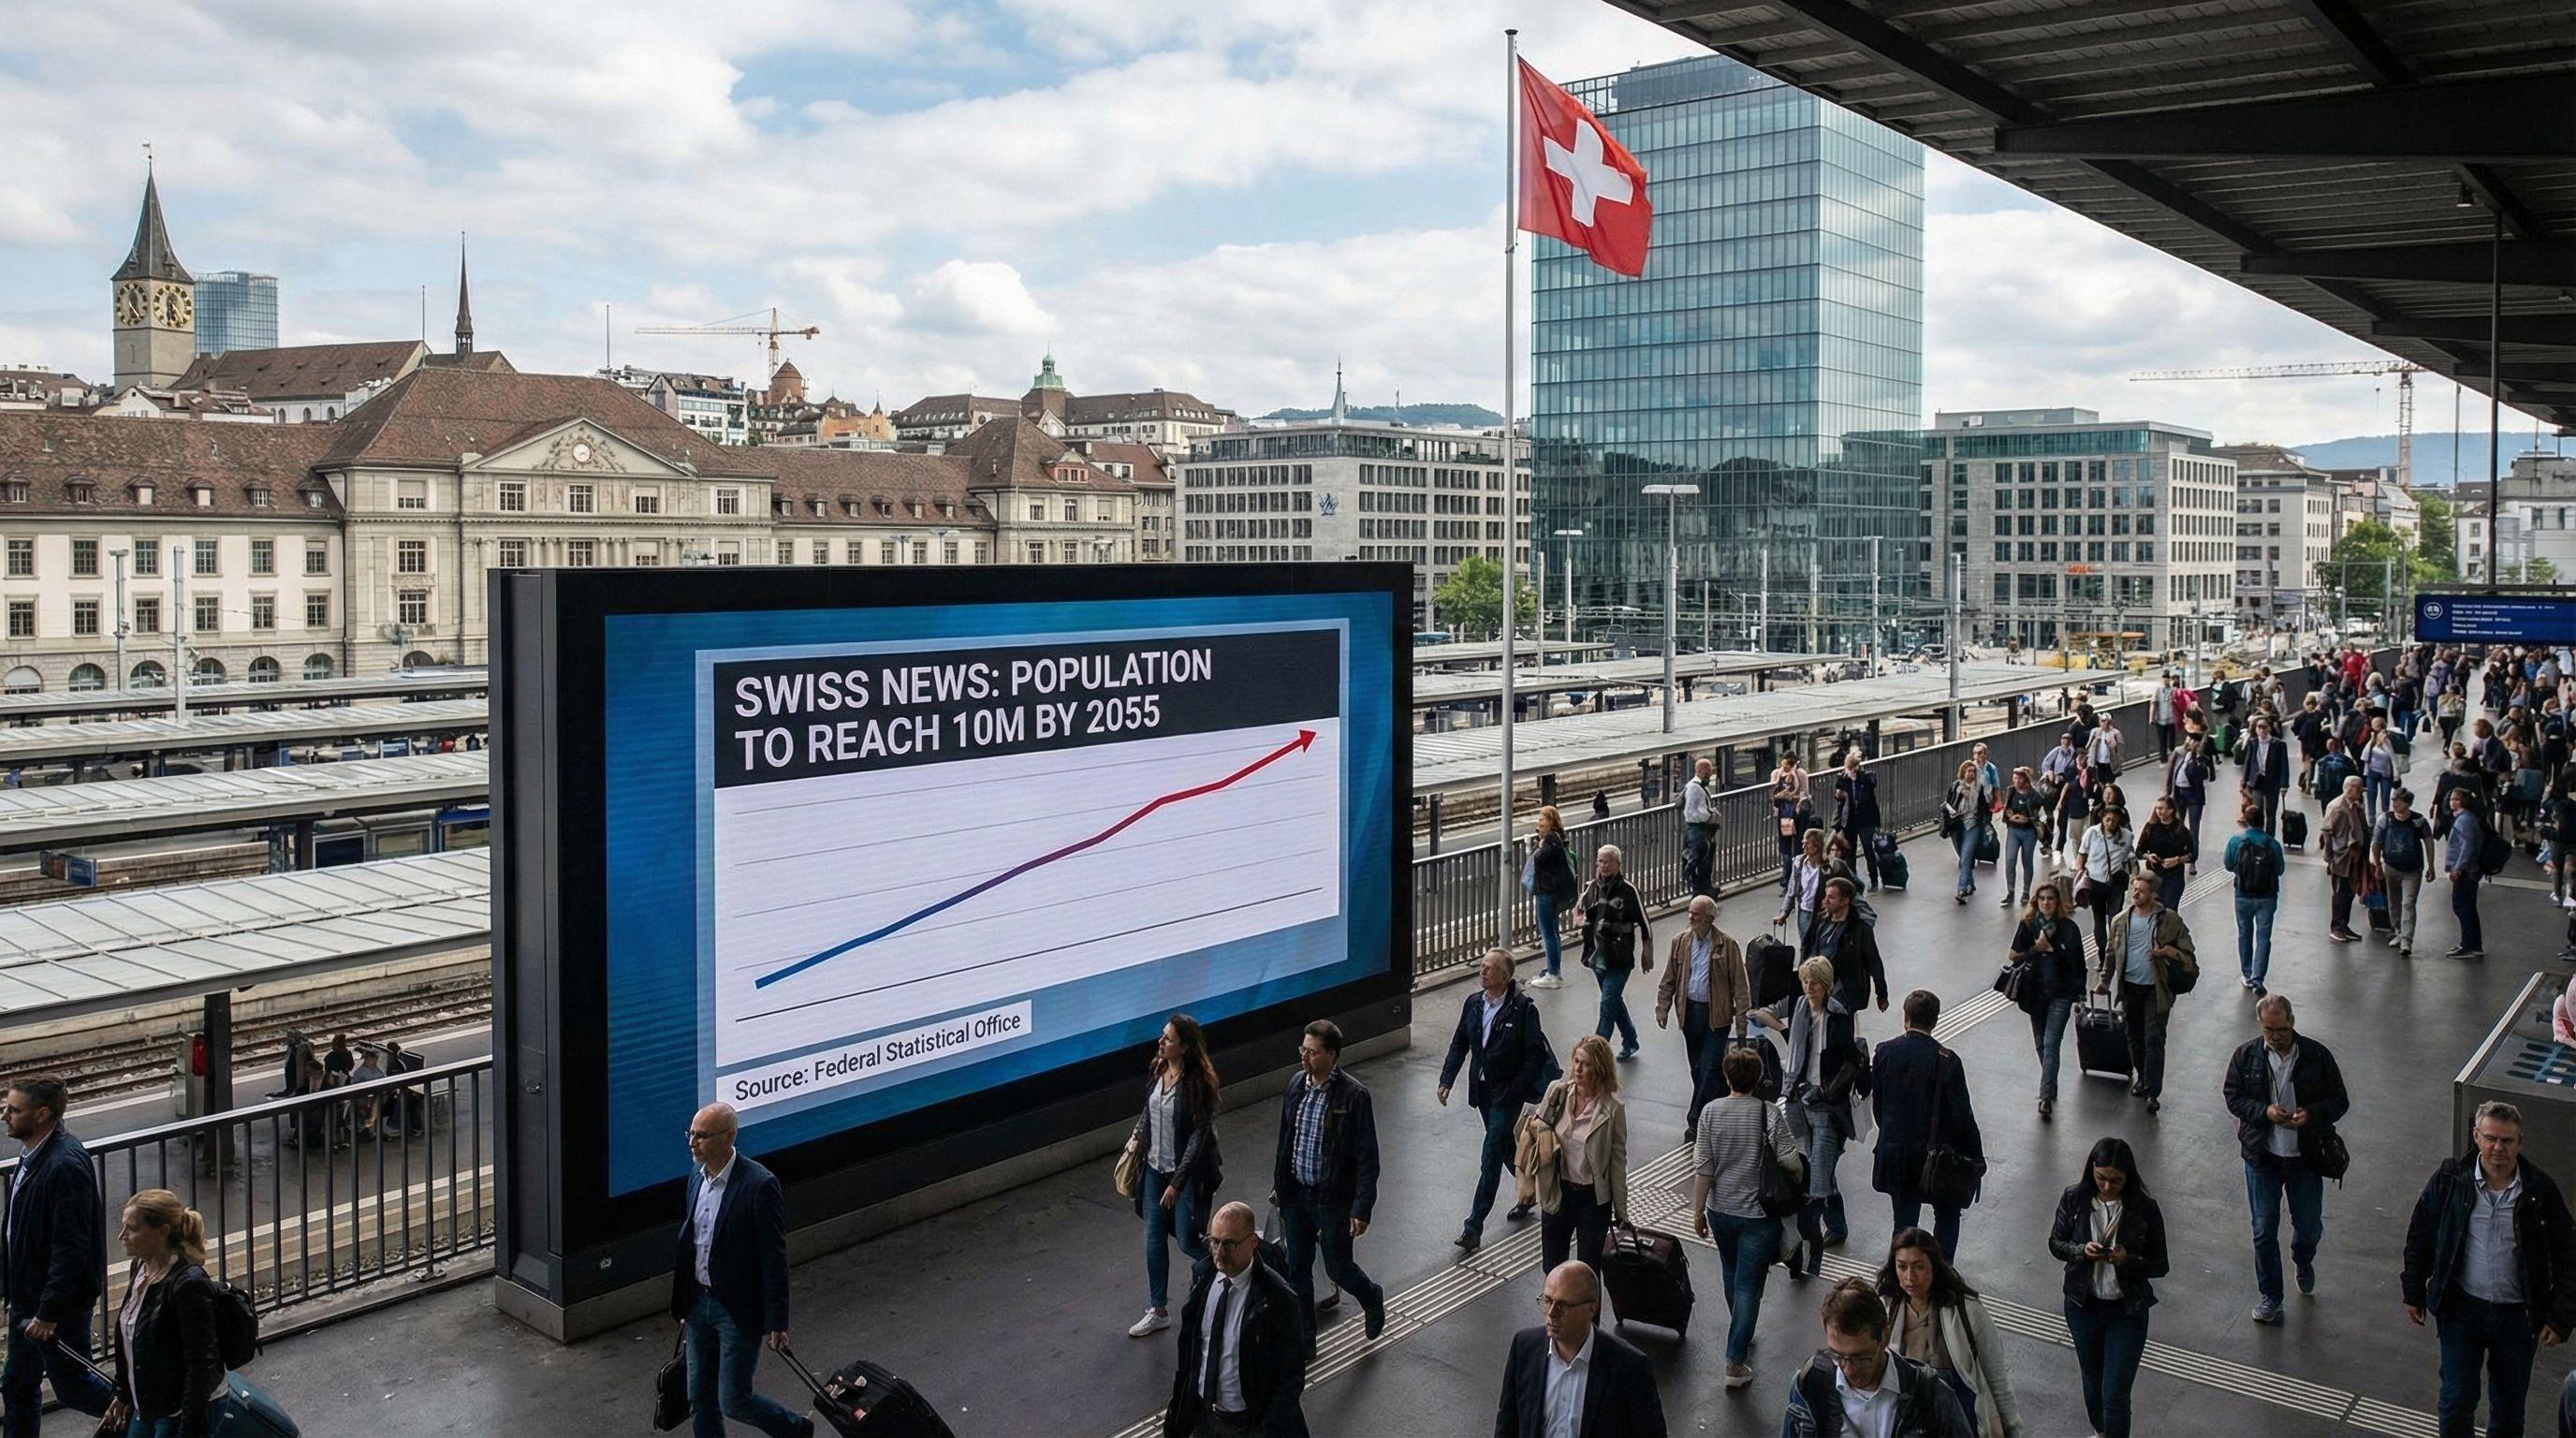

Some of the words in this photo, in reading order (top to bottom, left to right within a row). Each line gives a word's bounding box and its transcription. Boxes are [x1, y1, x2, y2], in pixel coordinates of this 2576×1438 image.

[735, 669, 870, 717] SWISS
[882, 662, 1000, 706] NEWS:
[1011, 648, 1211, 697] POPULATION
[735, 726, 794, 770] TO
[808, 713, 940, 764] REACH
[953, 706, 1025, 748] 10M
[1036, 701, 1078, 740] BY
[1086, 694, 1161, 734] 2055
[735, 1068, 809, 1101] Source:
[814, 1044, 881, 1081] Federal
[886, 1021, 970, 1062] Statistical
[974, 1014, 1021, 1038] Office
